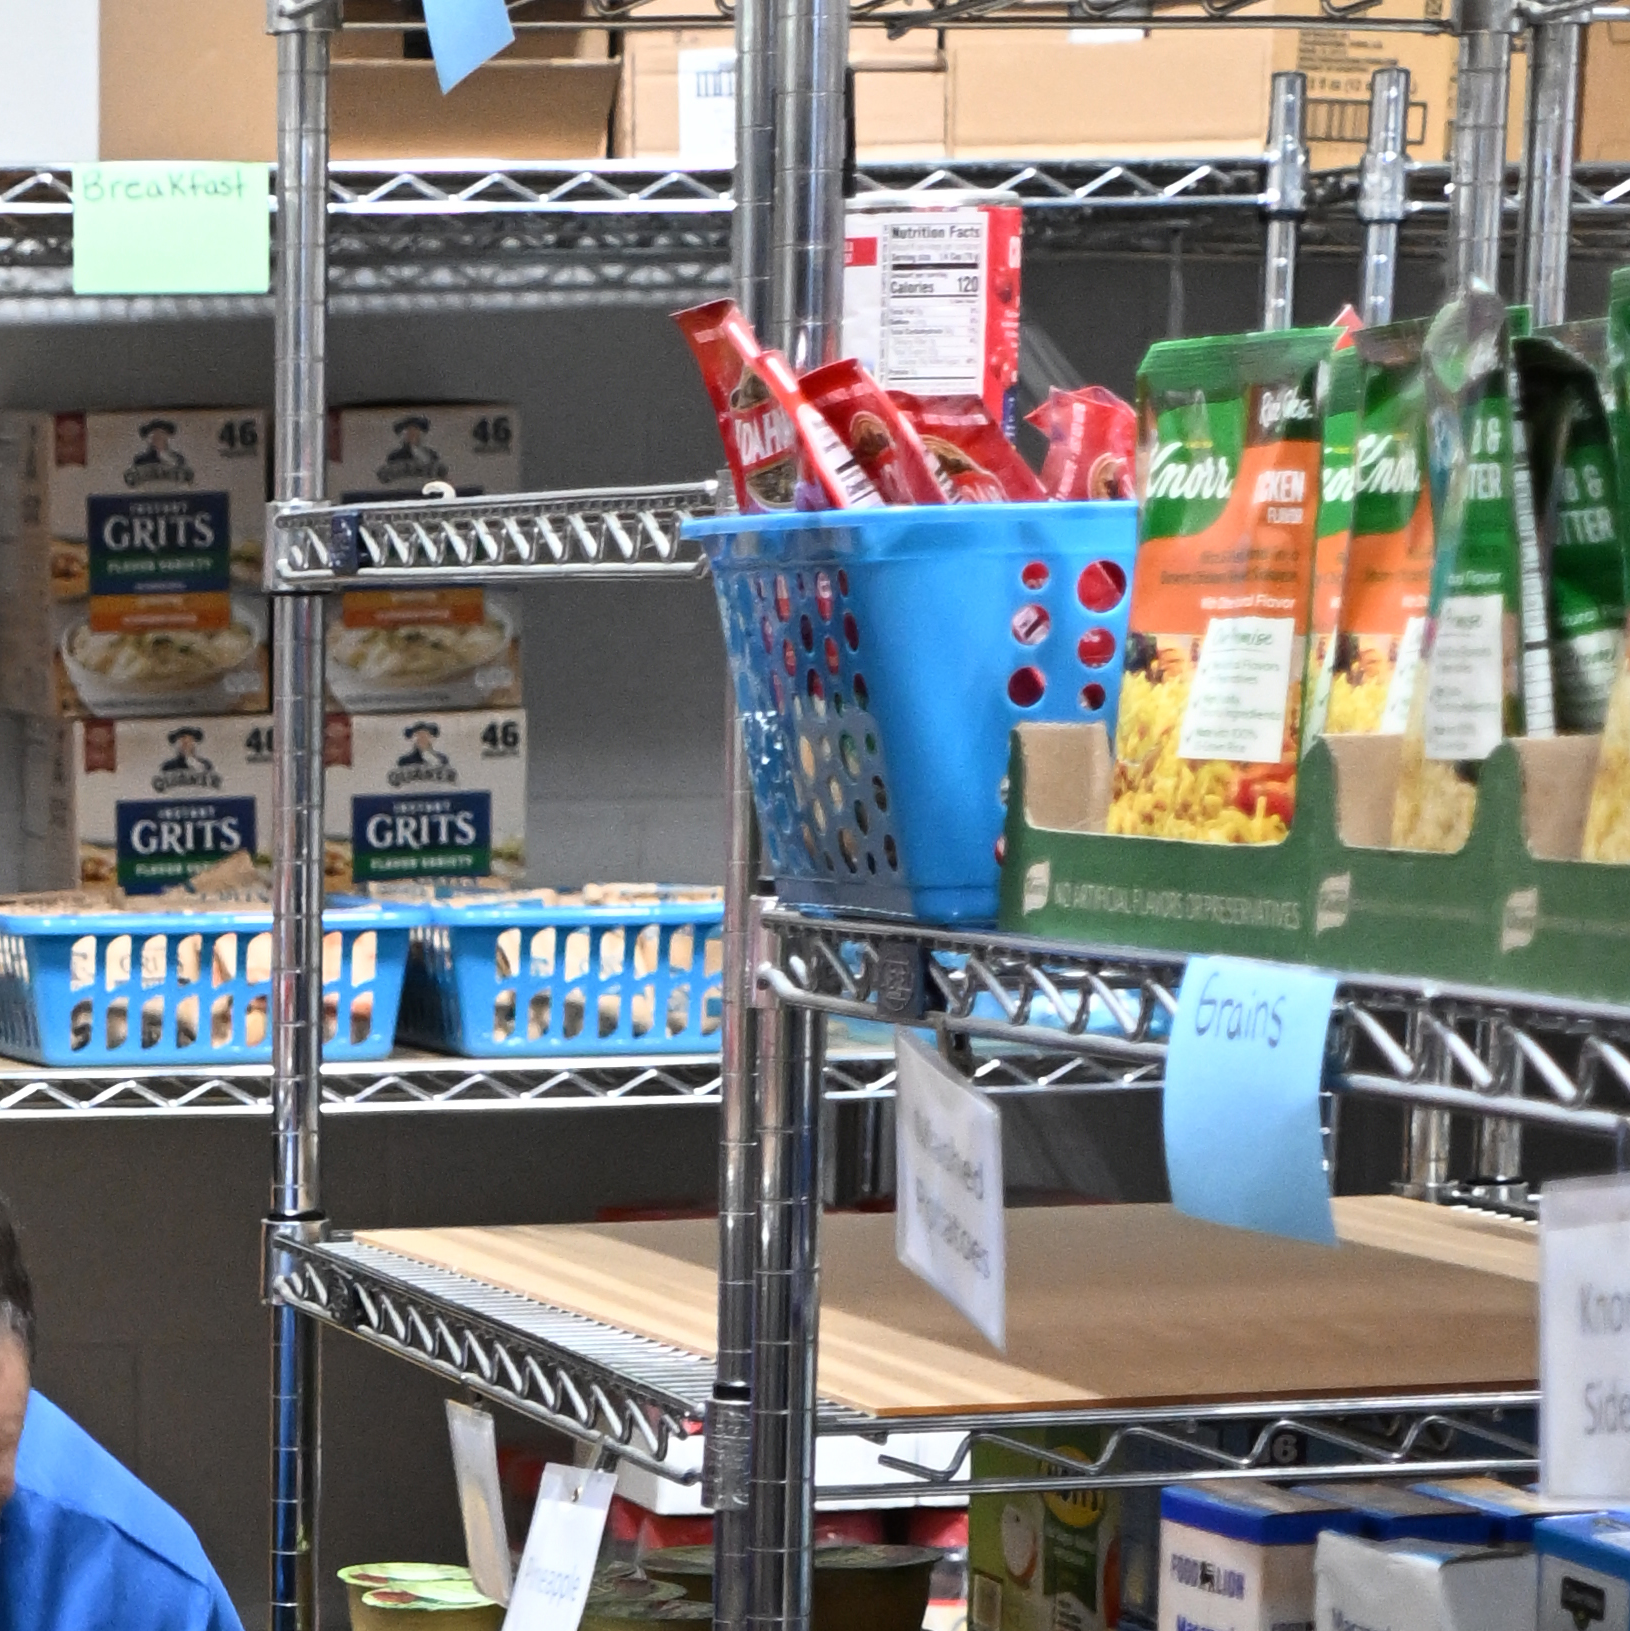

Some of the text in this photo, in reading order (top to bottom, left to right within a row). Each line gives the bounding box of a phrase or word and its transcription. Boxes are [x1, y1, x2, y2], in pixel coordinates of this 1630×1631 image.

[81, 171, 247, 201] Breakfast
[892, 226, 981, 239] Nutrition Facts
[890, 276, 979, 293] Calories 120
[218, 420, 258, 449] 46
[472, 416, 512, 446] 46
[102, 512, 216, 552] GRITS
[481, 722, 520, 750] 46
[130, 815, 242, 856] GRITS
[366, 811, 477, 852] GRITS
[1195, 972, 1286, 1049] Grains
